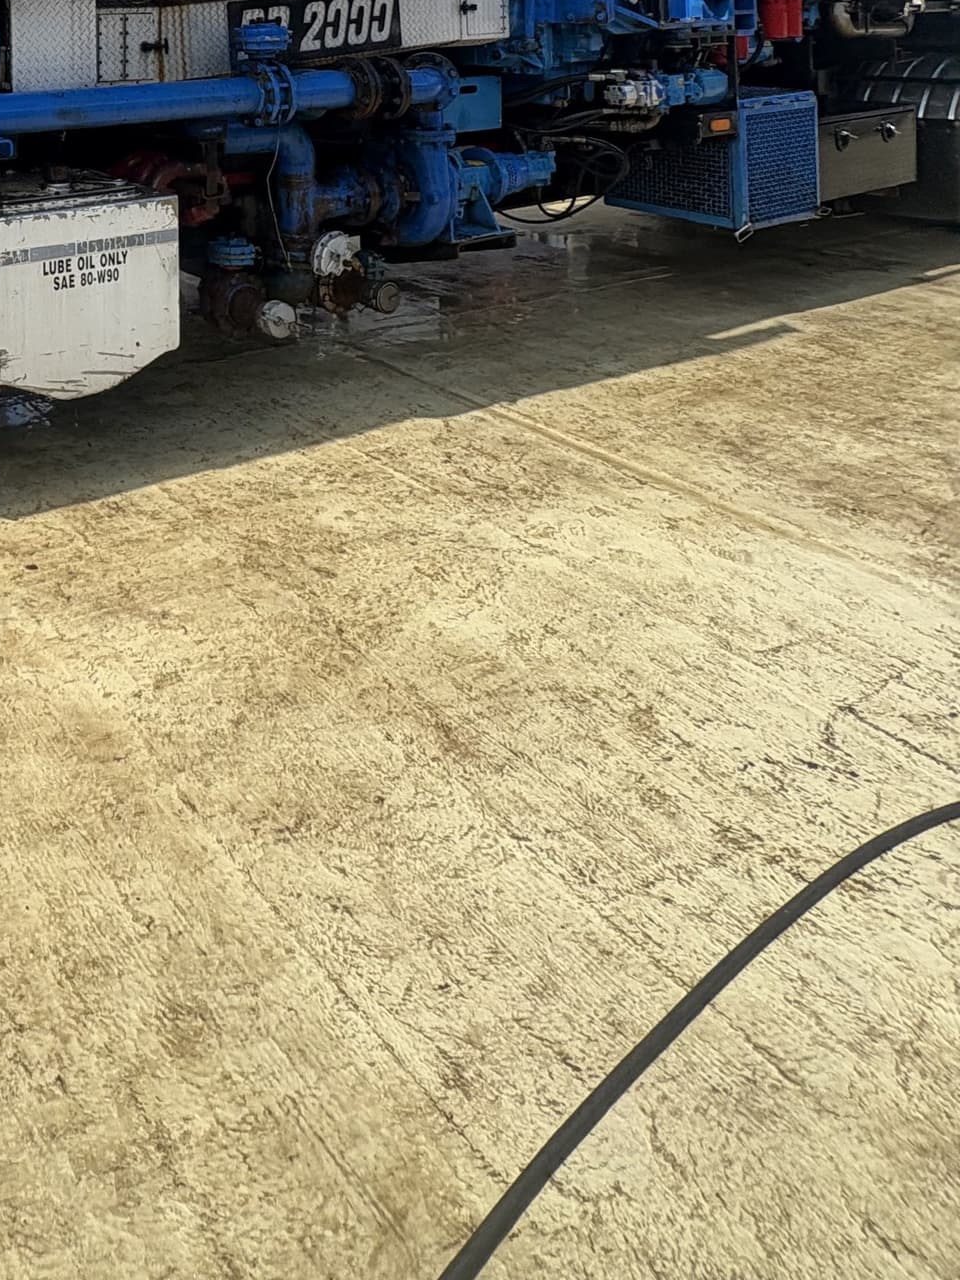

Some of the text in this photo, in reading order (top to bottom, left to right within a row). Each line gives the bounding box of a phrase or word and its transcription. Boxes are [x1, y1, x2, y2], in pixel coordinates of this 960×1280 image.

[42, 250, 128, 276] LUBE OIL ONLY
[53, 269, 119, 291] SAE 80-W90
